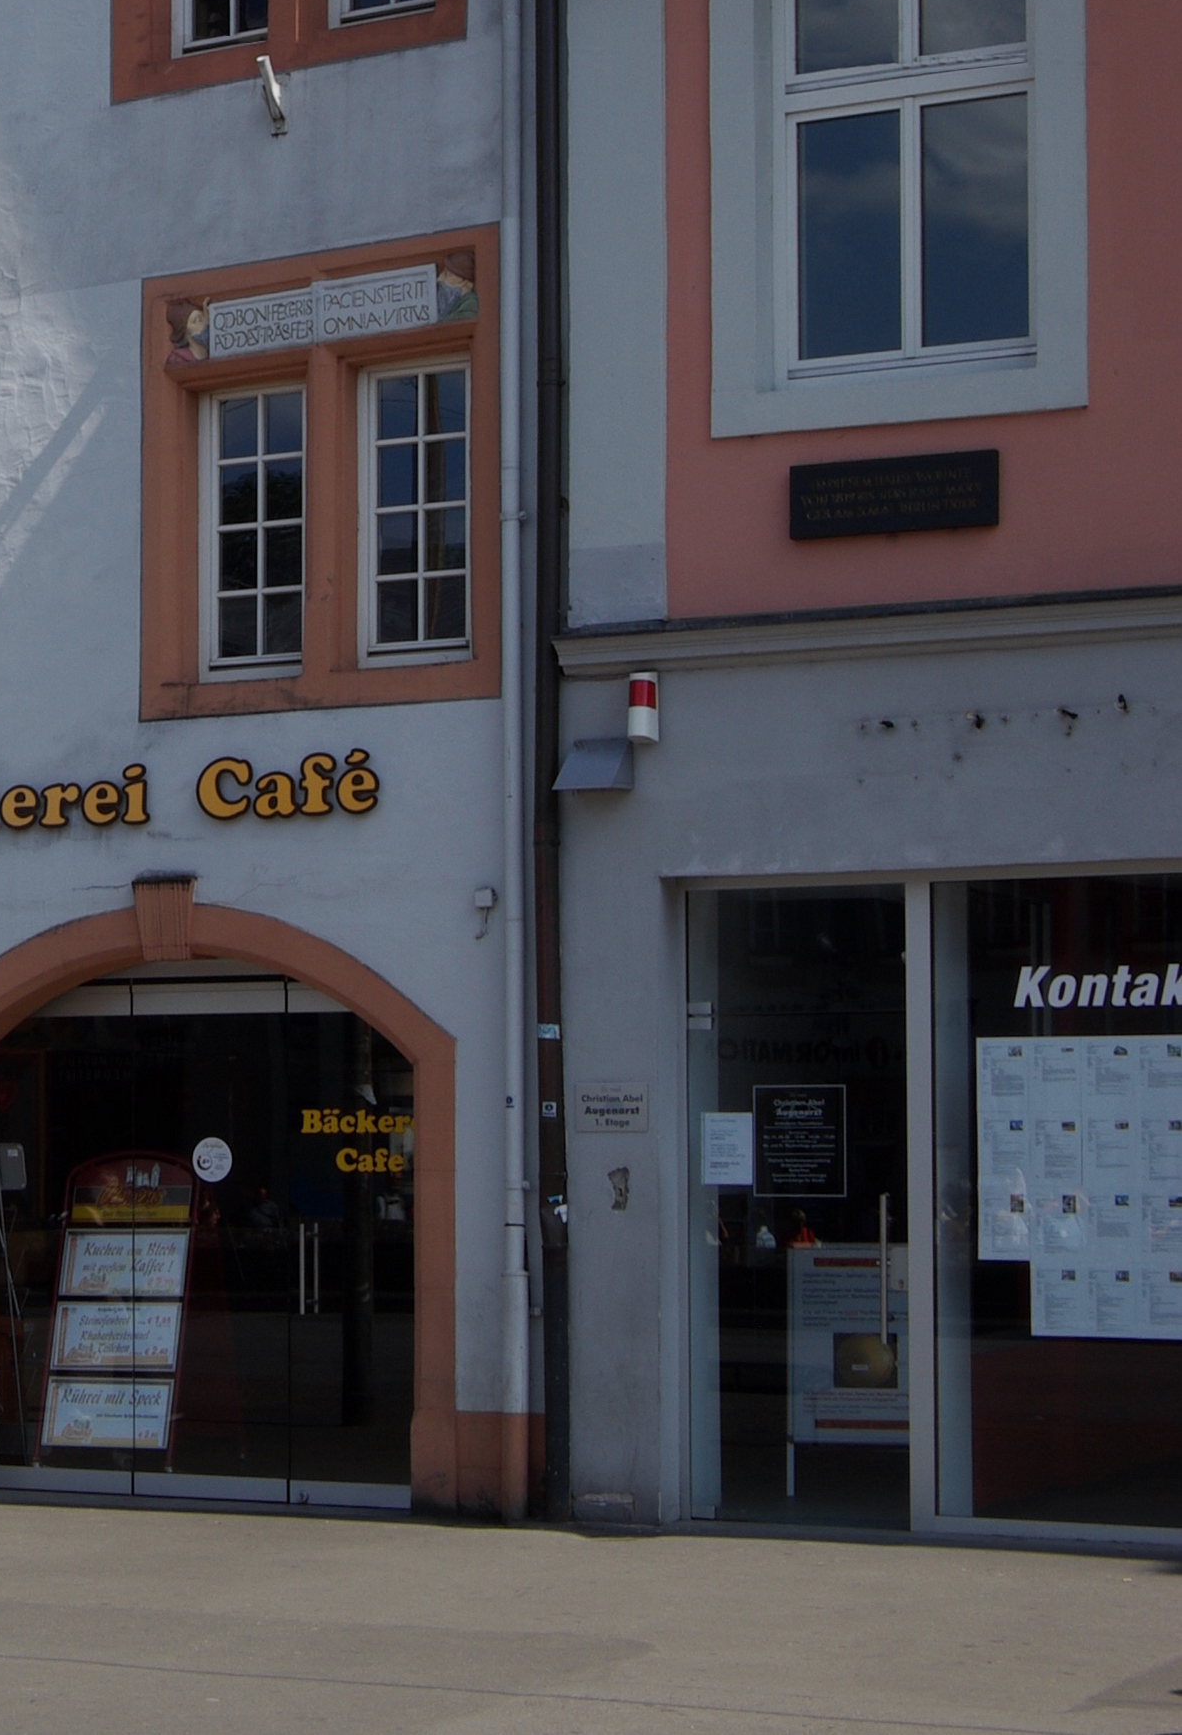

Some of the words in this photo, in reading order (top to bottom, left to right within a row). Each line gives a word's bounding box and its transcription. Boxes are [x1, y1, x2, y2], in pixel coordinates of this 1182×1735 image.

[196, 749, 380, 819] Café
[1013, 963, 1182, 1009] Kontak
[581, 1093, 621, 1103] Christian
[622, 1093, 643, 1103] Abel
[584, 1106, 640, 1117] Augenarzt
[300, 1108, 415, 1135] Bäcker
[605, 1118, 631, 1128] Etage
[335, 1146, 405, 1173] Cafe
[83, 1242, 125, 1257] Kuchen
[146, 1241, 177, 1257] Blech
[60, 1388, 104, 1405] Rührei
[104, 1389, 126, 1405] mit
[128, 1389, 162, 1407] Speck
